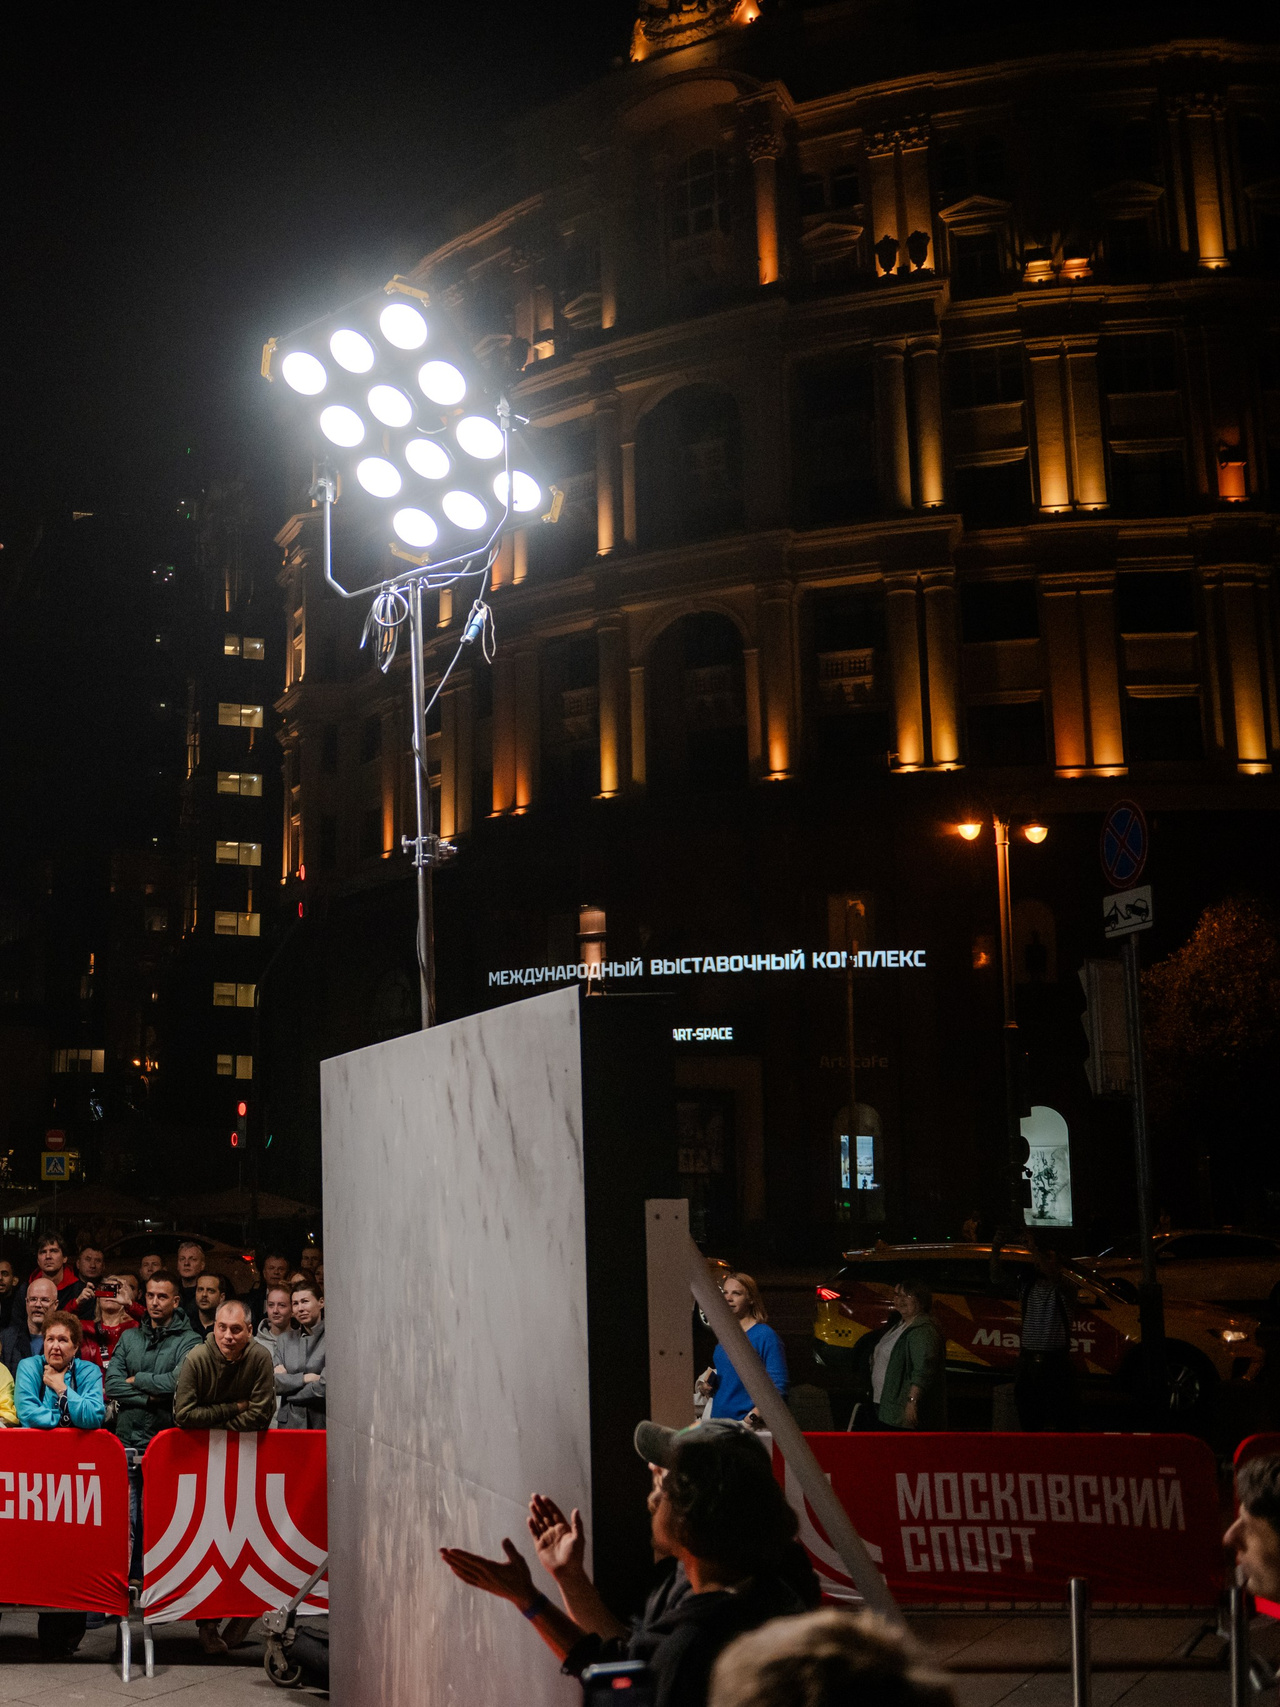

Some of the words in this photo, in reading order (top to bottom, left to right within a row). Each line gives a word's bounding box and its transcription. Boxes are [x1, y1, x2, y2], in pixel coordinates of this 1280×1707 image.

[488, 957, 643, 987] МЕЖДУНАРОДНЫЙ
[650, 948, 805, 976] ВЫСТАВОЧНЫЙ
[672, 1026, 734, 1042] ART-SPACE
[971, 1328, 1096, 1354] Мает
[895, 1467, 1187, 1532] МОСКОВСКИЙ
[900, 1525, 1037, 1573] СПОРТ
